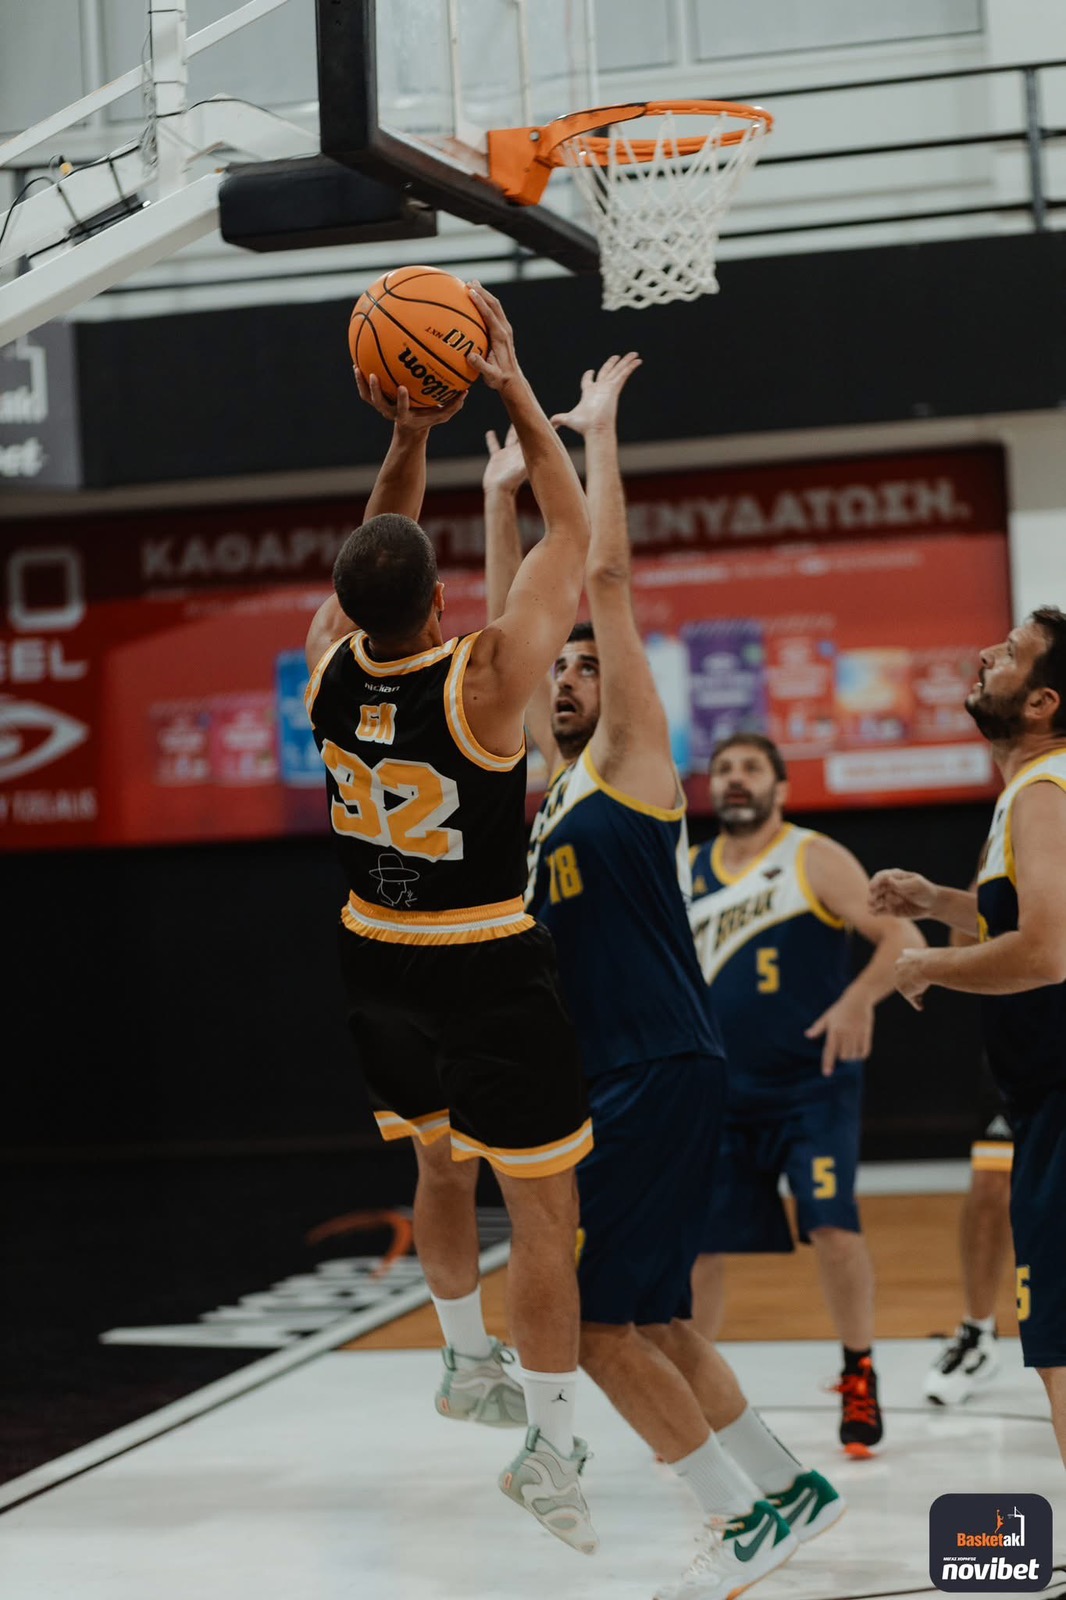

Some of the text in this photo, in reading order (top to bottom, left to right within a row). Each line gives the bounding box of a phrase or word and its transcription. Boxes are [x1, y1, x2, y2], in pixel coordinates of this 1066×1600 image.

[442, 328, 483, 358] VO
[320, 738, 464, 863] 32
[545, 845, 583, 906] 18
[756, 947, 781, 994] 5
[811, 1156, 837, 1200] 5
